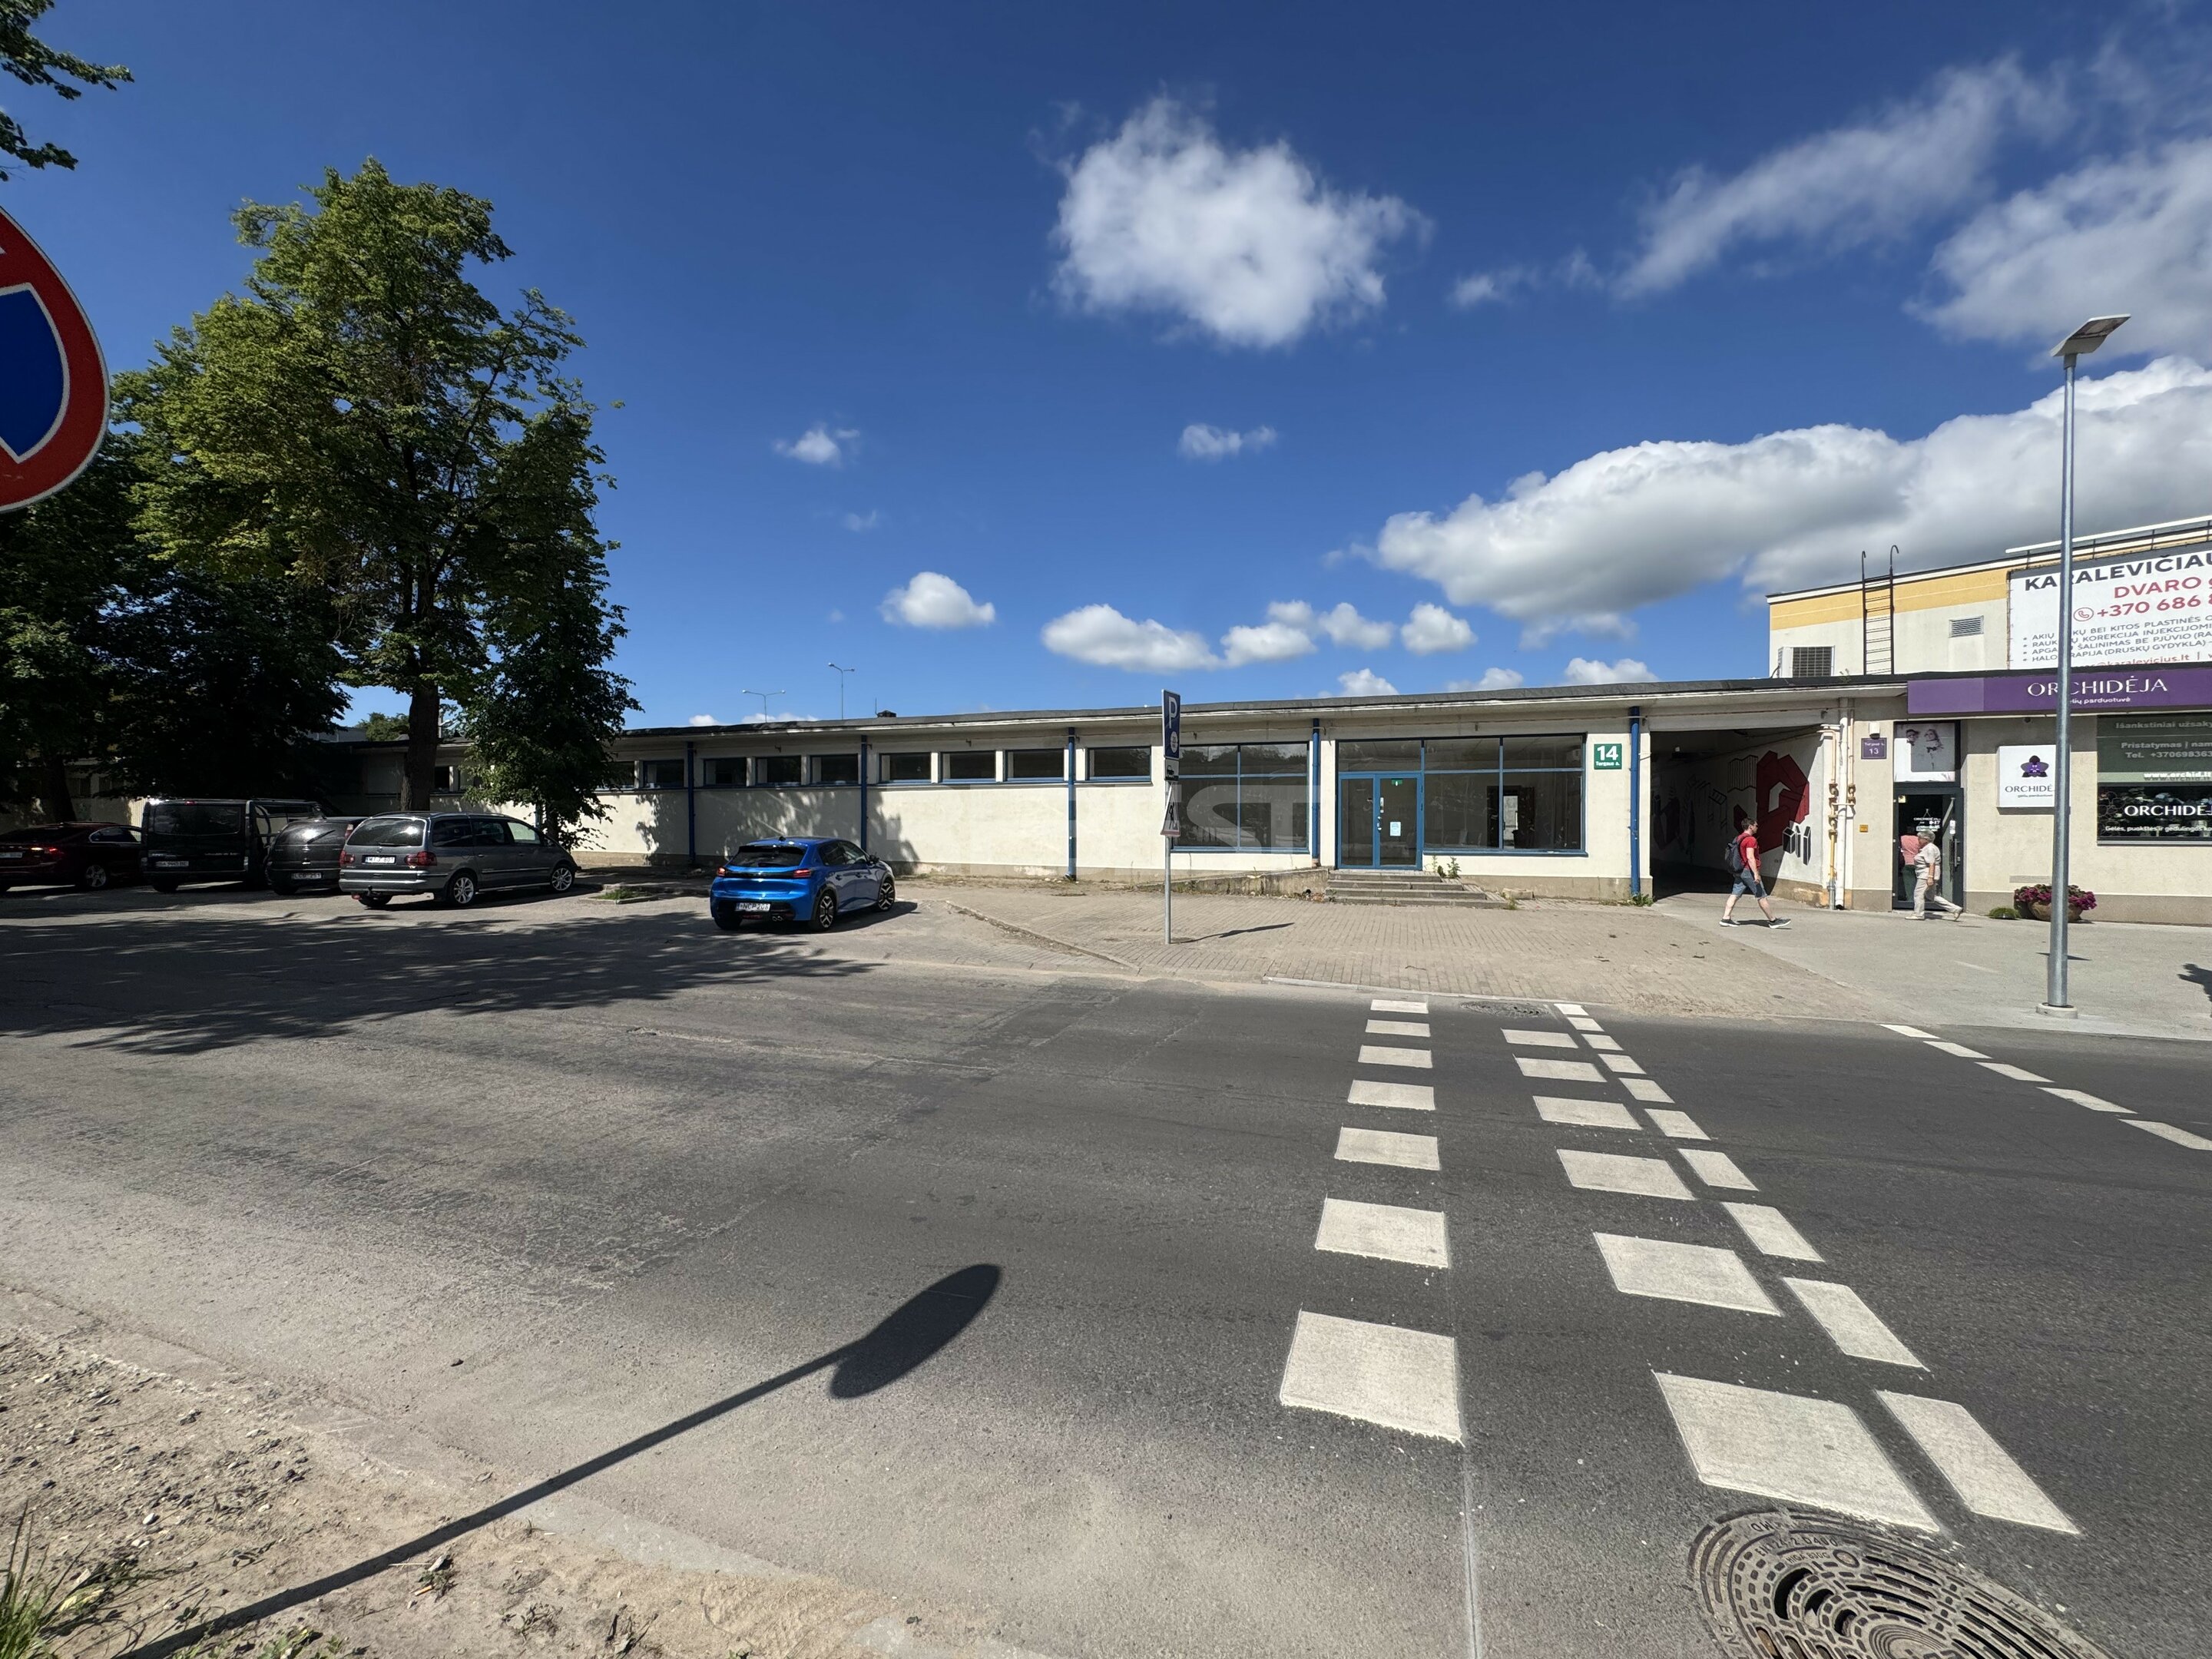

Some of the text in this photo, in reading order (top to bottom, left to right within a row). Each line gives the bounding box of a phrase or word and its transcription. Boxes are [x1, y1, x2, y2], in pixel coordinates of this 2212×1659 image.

[2025, 553, 2212, 591] KAALEVIČIA
[2114, 577, 2201, 598] DVARO
[2098, 601, 2150, 617] +370
[2157, 595, 2201, 611] 686
[2144, 616, 2201, 628] PLASTINĖS
[2078, 639, 2131, 650] ŠALINIMAS
[2153, 634, 2191, 642] PJŪVIO
[2083, 631, 2139, 642] KOREKCIJA
[2152, 640, 2206, 651] GYDYKLA)
[1168, 696, 1177, 729] P
[1598, 745, 1618, 760] 14
[2005, 783, 2055, 793] ORCHIDĖ
